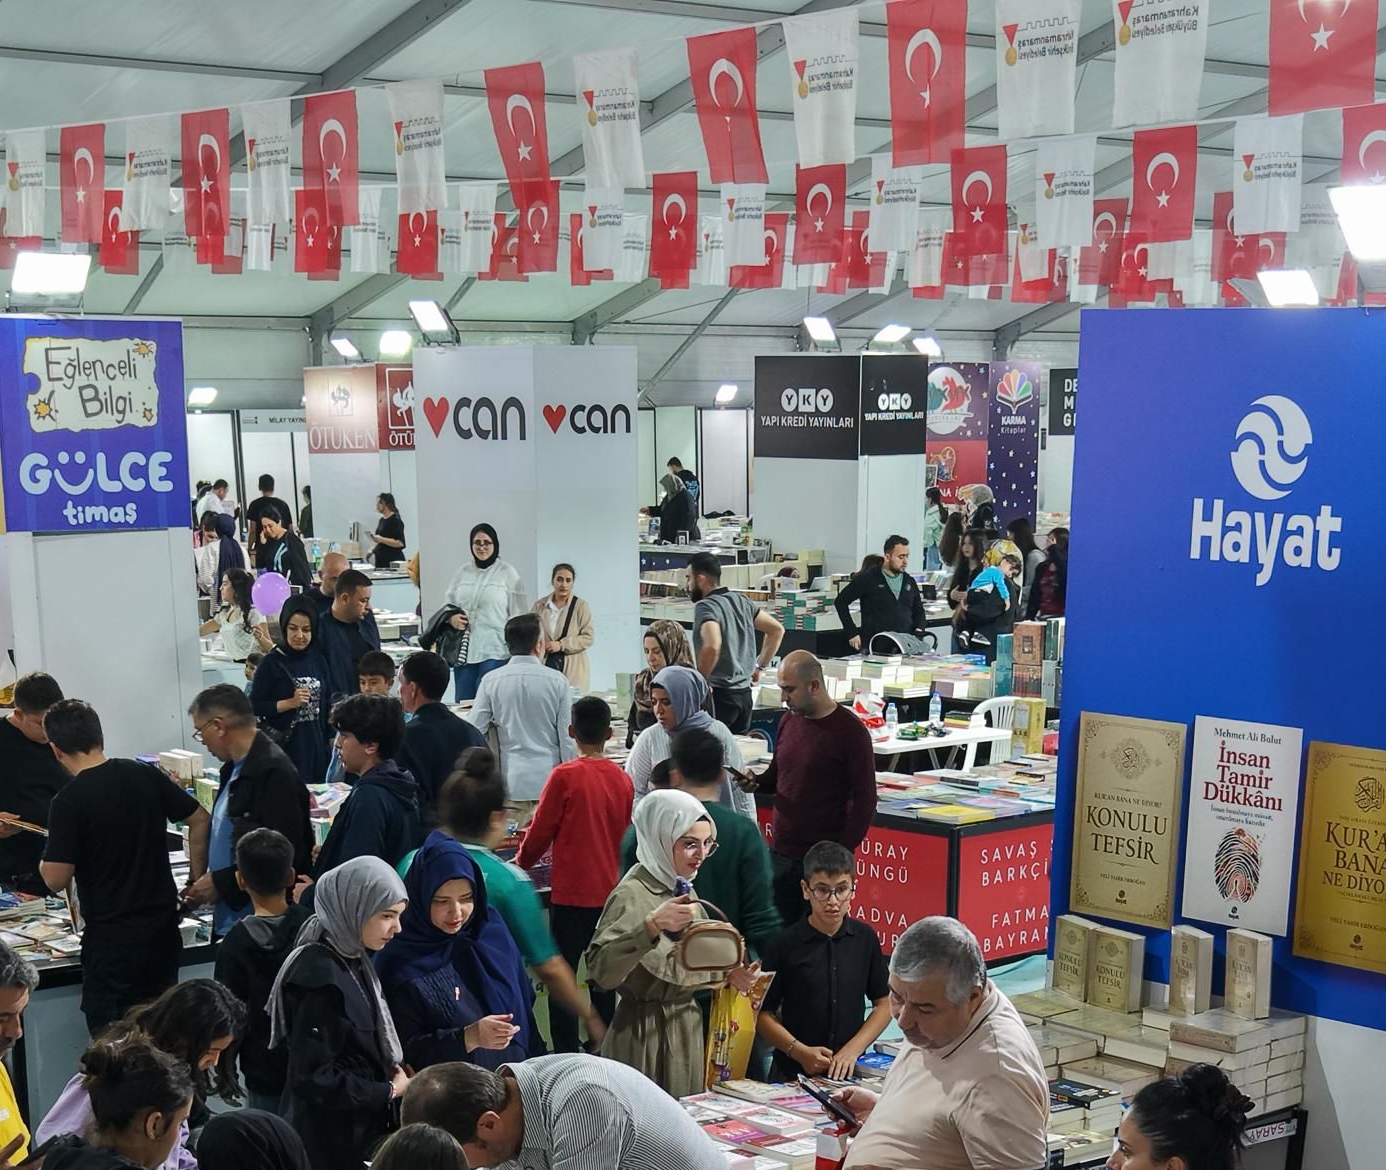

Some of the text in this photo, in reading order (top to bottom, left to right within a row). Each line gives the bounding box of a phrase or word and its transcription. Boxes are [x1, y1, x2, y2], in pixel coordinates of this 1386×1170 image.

[45, 347, 138, 389] Eğlenceli
[78, 384, 134, 424] Bilgi
[864, 412, 878, 421] YAPI
[453, 397, 526, 440] can
[570, 404, 631, 434] can
[761, 414, 854, 428] YAPI KREDİ YAYINLARI
[1001, 416, 1026, 426] KARMA
[1001, 426, 1026, 435] Kitaplar
[309, 421, 376, 450] ÖTÜKEN
[19, 451, 173, 495] GÜLCE
[63, 500, 137, 525] timaş
[1189, 498, 1342, 586] Hayat
[1214, 727, 1282, 745] Mehmet Ali Bulut
[1218, 739, 1270, 769] İnsan
[1216, 764, 1273, 790] Tamir
[1203, 781, 1283, 812] Dükkânı
[1086, 805, 1168, 835] KONULU
[981, 841, 1038, 864] SAVAŞ
[1091, 832, 1159, 865] TEFSİR
[1322, 871, 1343, 887] NE
[992, 906, 1049, 929] FATMA
[1096, 965, 1126, 979] KONULU
[1097, 975, 1122, 990] TEFSİR
